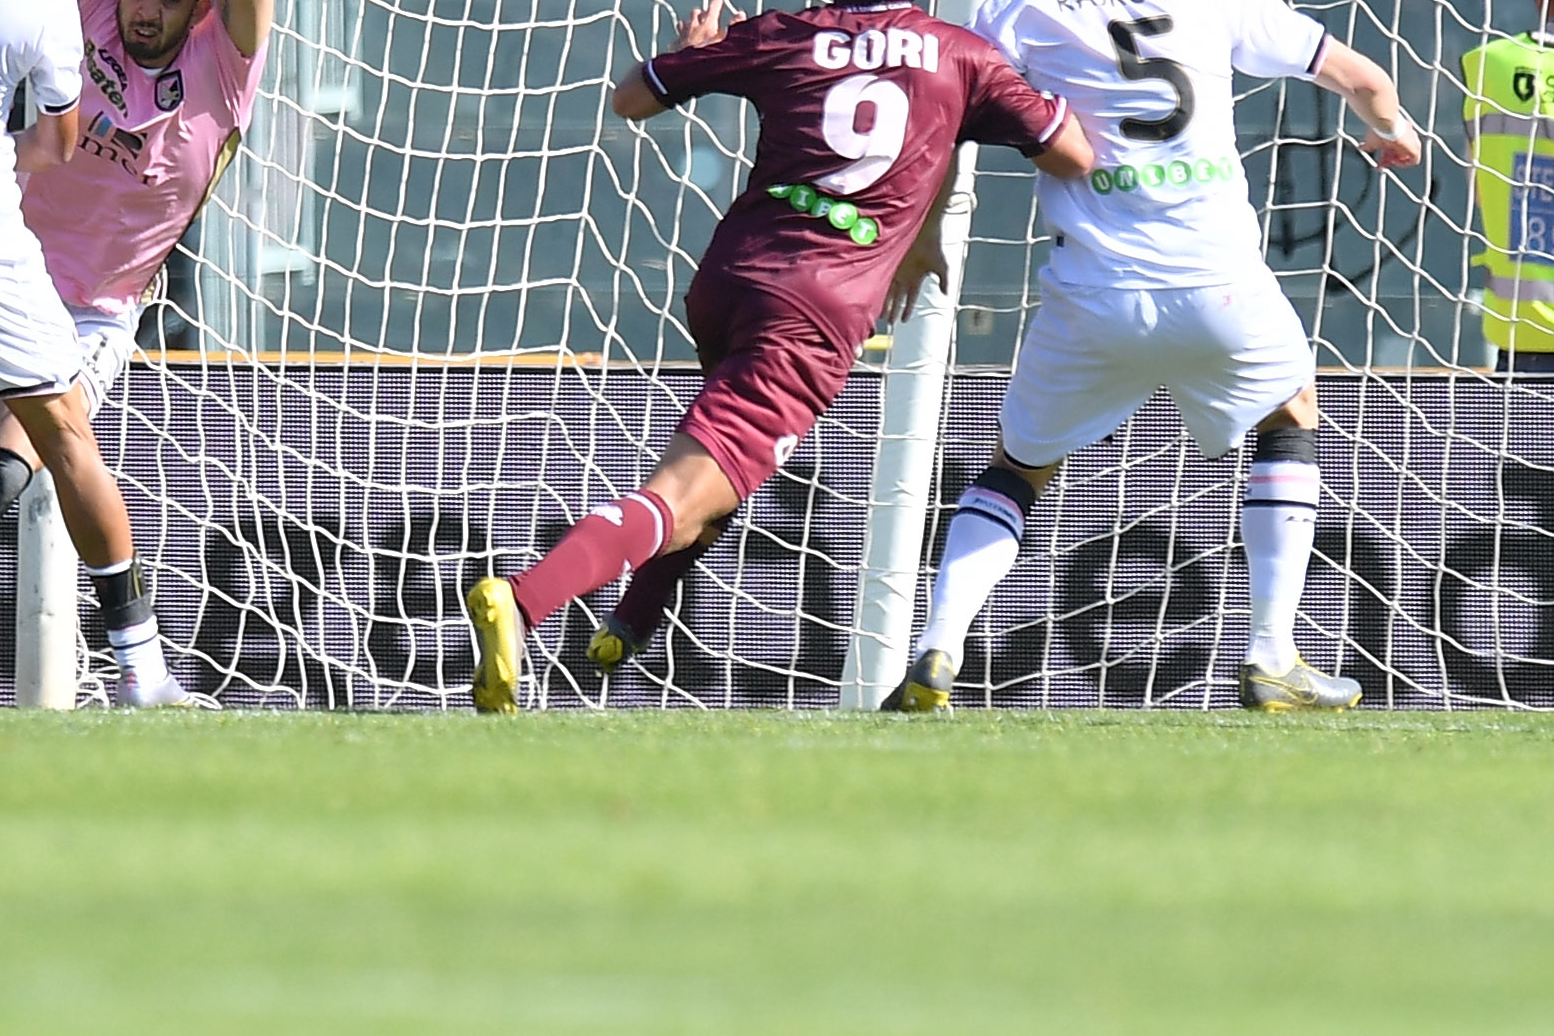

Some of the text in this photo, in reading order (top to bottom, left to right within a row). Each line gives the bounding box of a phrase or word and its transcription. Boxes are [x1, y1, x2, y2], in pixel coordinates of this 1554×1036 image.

[812, 27, 940, 74] GORI
[1107, 14, 1195, 142] 5
[813, 73, 911, 195] 9
[1092, 157, 1234, 195] UNIBET
